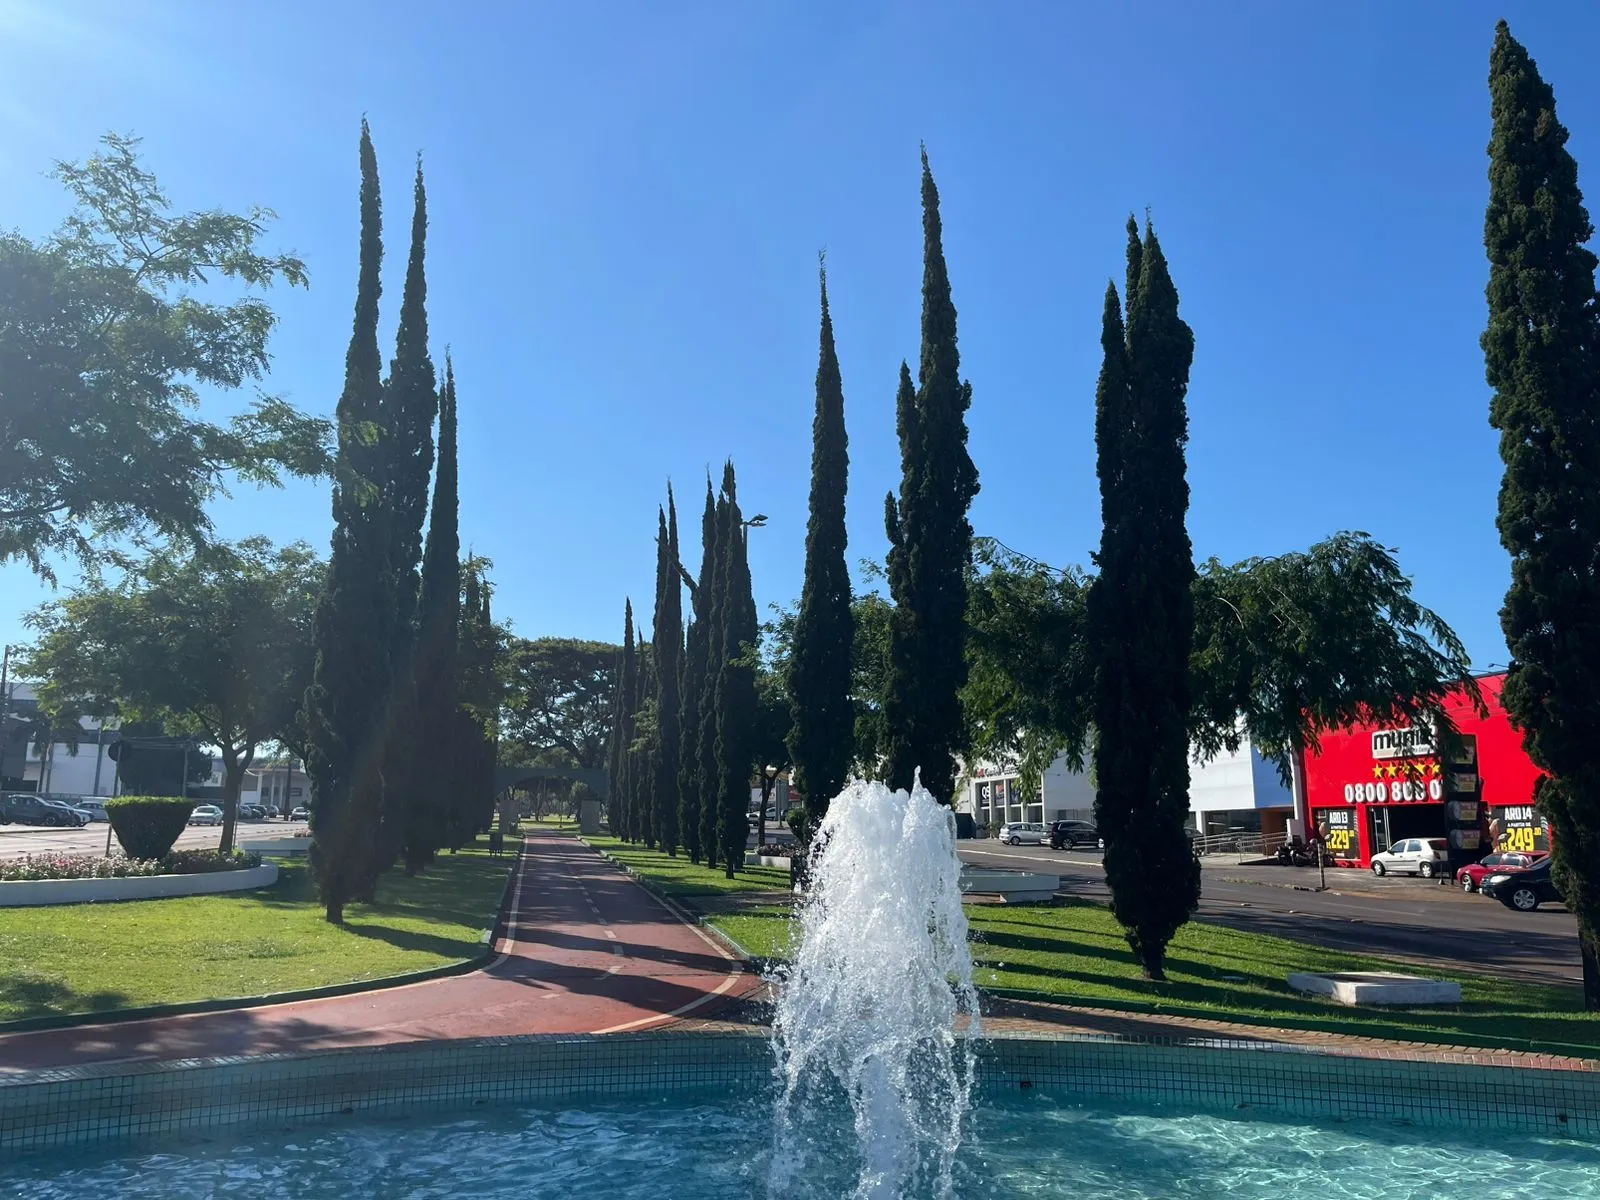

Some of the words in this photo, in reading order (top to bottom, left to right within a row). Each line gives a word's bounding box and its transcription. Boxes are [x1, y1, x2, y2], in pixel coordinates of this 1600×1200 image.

[1373, 728, 1435, 751] muni
[1344, 782, 1386, 803] 0800
[1341, 811, 1348, 824] 13
[1504, 807, 1521, 821] ARO
[1521, 806, 1532, 820] 14
